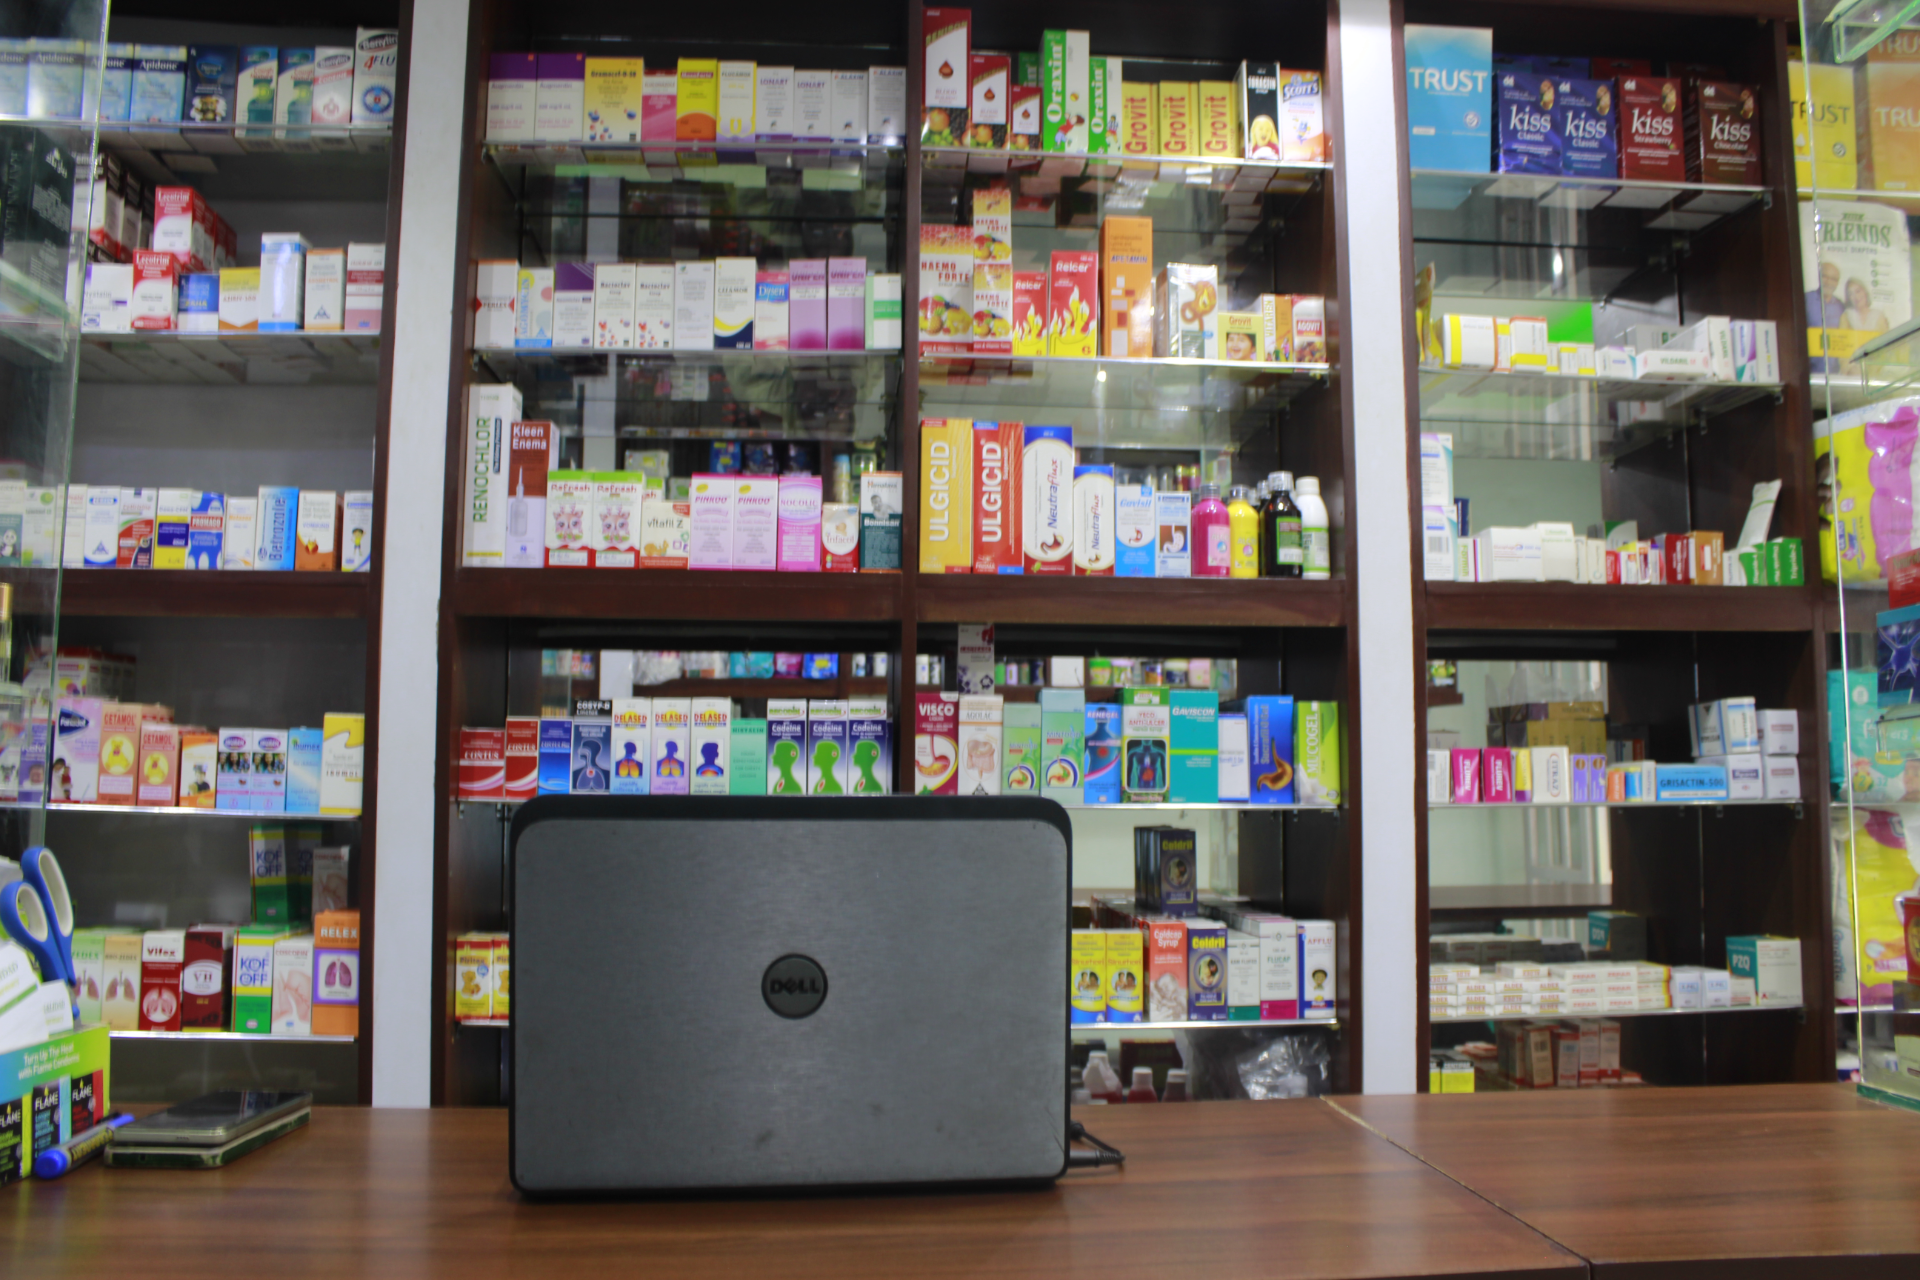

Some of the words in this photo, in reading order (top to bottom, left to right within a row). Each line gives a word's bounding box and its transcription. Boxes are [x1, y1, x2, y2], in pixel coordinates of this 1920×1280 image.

[36, 53, 75, 64] Apidone
[139, 59, 178, 70] Apidone
[364, 54, 396, 71] 4FLU
[760, 77, 789, 86] LONART
[797, 81, 826, 89] LONART
[1046, 40, 1063, 123] Oraxin
[1409, 67, 1489, 93] TRUST
[1090, 65, 1104, 134] Oraxin
[1163, 95, 1187, 153] Grovit
[1203, 95, 1228, 152] Grovit
[1510, 103, 1552, 133] kiss
[1565, 109, 1607, 139] kiss
[1631, 107, 1674, 136] kiss
[1124, 96, 1148, 154] Grovit
[1710, 113, 1751, 142] kiss
[1517, 131, 1545, 142] Classic
[1572, 137, 1599, 149] Classic
[975, 219, 999, 227] HAEMO
[1814, 221, 1892, 249] FRIENDS
[1110, 255, 1148, 264] APETAMIN
[921, 261, 957, 272] HAEMO
[1056, 261, 1089, 273] Relcer
[1015, 281, 1041, 291] Relcer
[1229, 315, 1252, 326] Grovit
[1297, 321, 1321, 331] AGOVIT
[513, 424, 544, 438] Kleen
[512, 438, 547, 450] Enema
[472, 415, 491, 523] RENOCHLOR
[929, 440, 950, 542] ULGICID
[981, 440, 1003, 543] ULGICID
[1047, 458, 1059, 529] Neutraflux
[647, 518, 674, 528] vitafil
[676, 518, 683, 528] Z
[863, 517, 900, 528] Bonnisan
[1090, 493, 1101, 551] Neutraflux
[268, 497, 286, 562] Betrozole
[826, 533, 856, 544] Infacol
[1461, 544, 1470, 577] Formin
[919, 703, 955, 717] VISCO
[965, 711, 993, 721] AGOLAC
[1087, 711, 1119, 719] RENEGEL
[1172, 706, 1215, 717] GAVISCON
[104, 712, 136, 726] CETAMOL
[614, 713, 648, 724] DELASED
[655, 713, 688, 723] DELASED
[694, 712, 728, 723] DELASED
[771, 724, 801, 733] Codeine
[812, 725, 843, 733] Codeine
[852, 724, 882, 733] Codeine
[143, 733, 173, 745] CETAMOL
[1306, 713, 1319, 774] MUCOGEL
[507, 742, 537, 752] CONTUS
[464, 749, 500, 761] CONTUS
[1463, 758, 1473, 792] FLUREV
[1495, 758, 1504, 792] FLUREV
[1551, 759, 1560, 792] ITRAZ
[1660, 778, 1725, 788] GRISACTIN-500
[1162, 840, 1193, 851] Coldril
[256, 849, 283, 864] KOF
[257, 864, 283, 877] OFF
[320, 927, 358, 940] RELEX
[1154, 931, 1182, 940] Coldcap
[1158, 939, 1178, 949] Syrup
[1192, 936, 1225, 949] Coldril
[147, 947, 176, 958] Vifex
[240, 956, 267, 972] KOF
[1267, 956, 1291, 964] FLUCAP
[1732, 954, 1751, 971] PZQ
[192, 971, 213, 983] VH
[240, 972, 267, 987] OFF
[770, 978, 821, 995] DELL
[23, 1051, 39, 1066] Turn
[49, 1045, 60, 1058] The
[60, 1042, 74, 1057] Heat
[18, 1066, 33, 1081] with
[33, 1062, 52, 1078] Flame
[53, 1053, 80, 1073] Condoms
[72, 1083, 93, 1102] FLAME
[35, 1090, 59, 1112] FLAME
